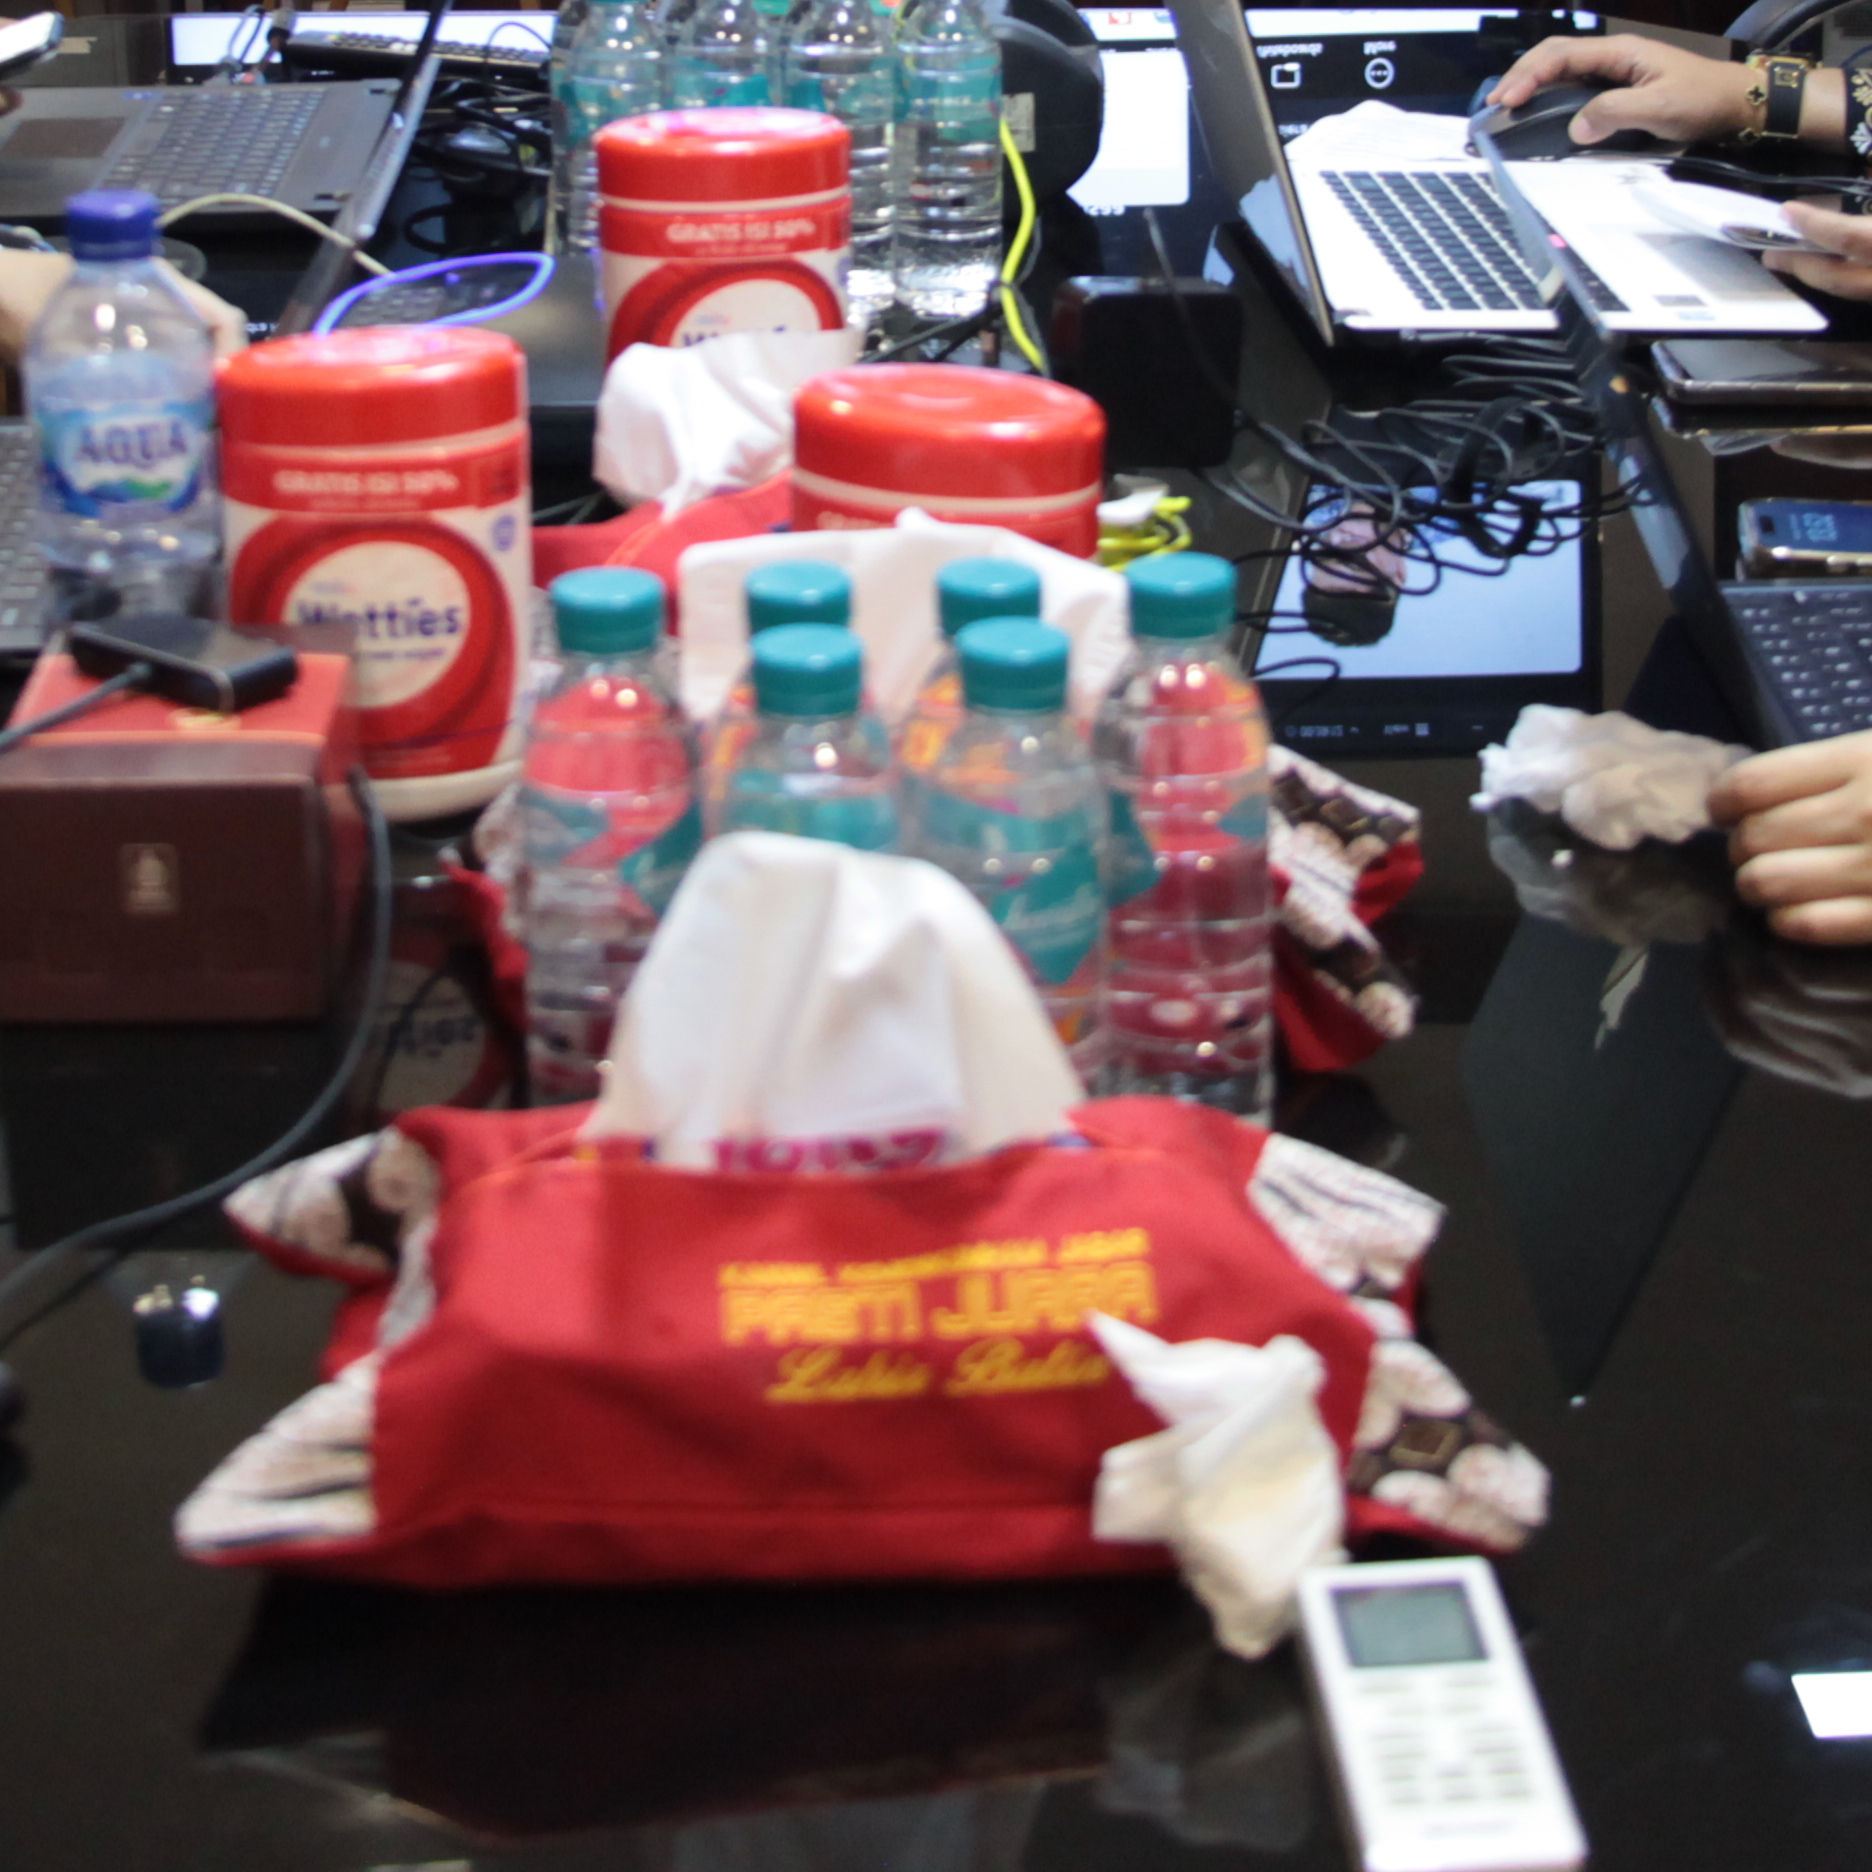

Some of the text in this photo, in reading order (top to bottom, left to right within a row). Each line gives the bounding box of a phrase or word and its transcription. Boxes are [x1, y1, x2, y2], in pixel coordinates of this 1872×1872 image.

[666, 221, 742, 244] GRATIS
[74, 418, 189, 469] AQUA
[272, 469, 361, 495] GRATIS
[722, 1260, 1160, 1347] PASTI JUARA
